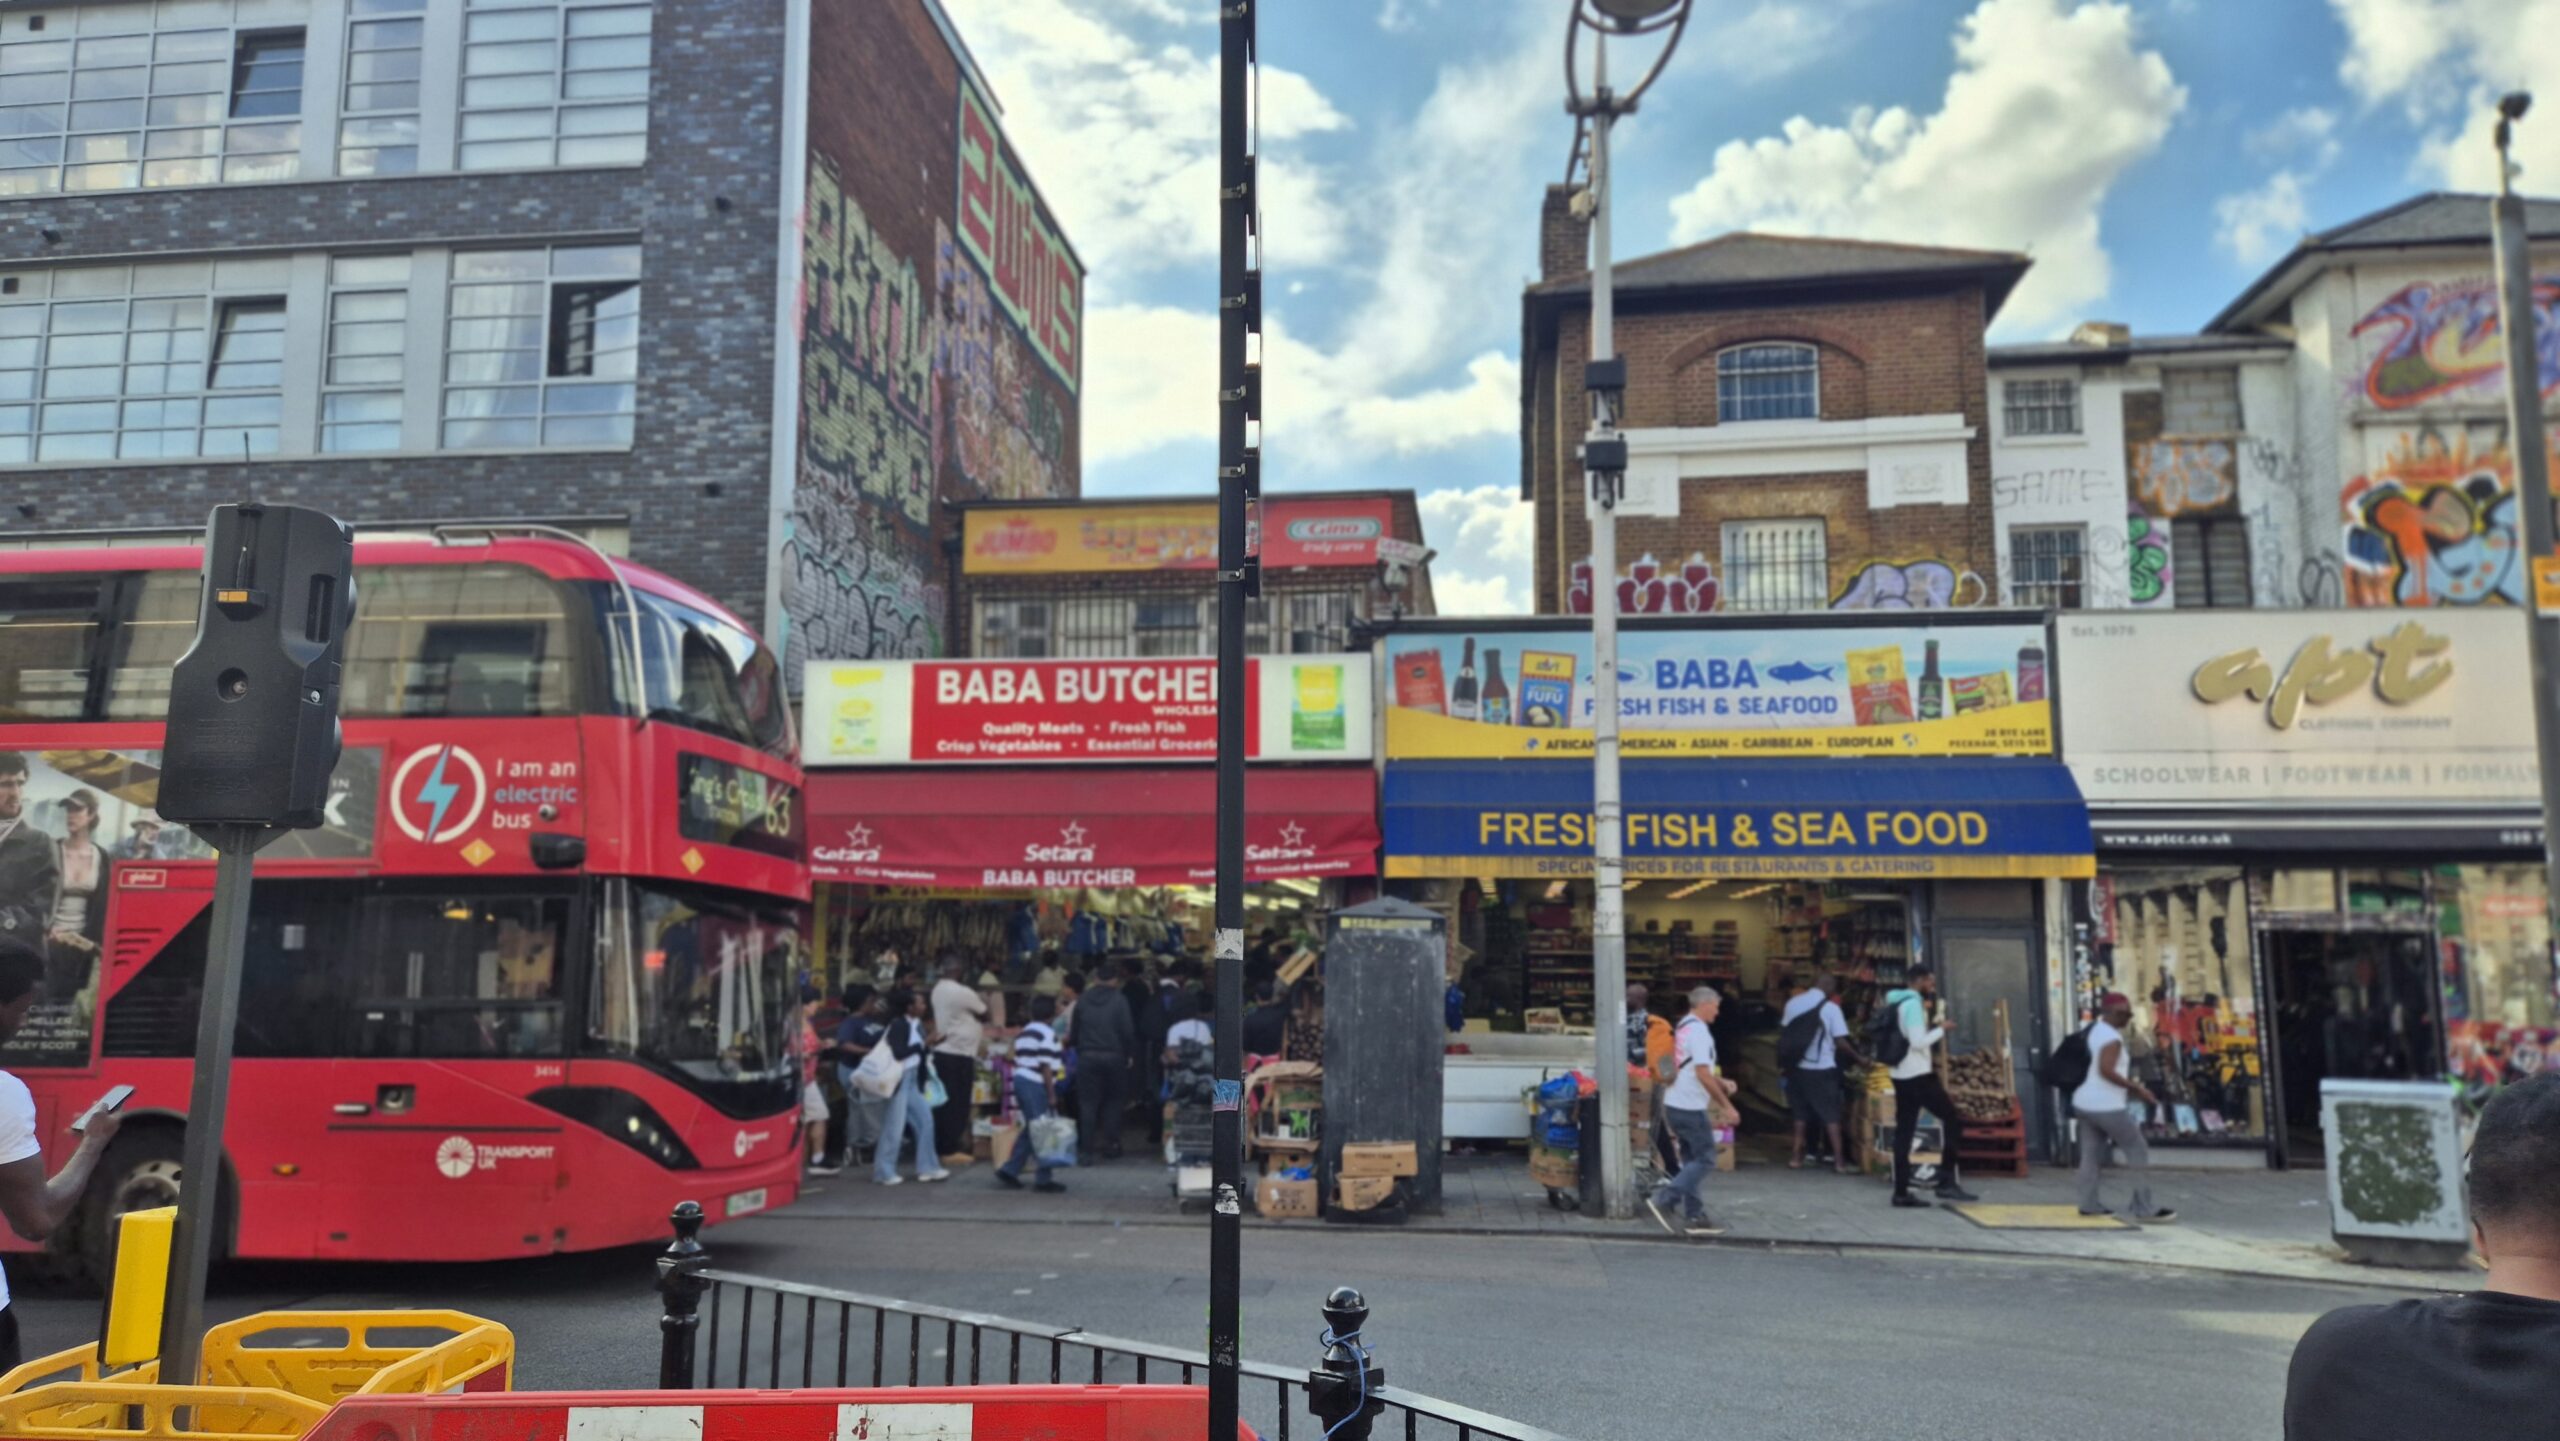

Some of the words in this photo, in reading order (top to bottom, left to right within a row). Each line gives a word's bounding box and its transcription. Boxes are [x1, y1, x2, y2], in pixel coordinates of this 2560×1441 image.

[1994, 468, 2115, 509] SAME
[1656, 659, 1759, 690] BABA
[2190, 619, 2455, 730] apt
[937, 668, 1044, 704] BABA
[1151, 706, 1218, 716] WHOLESA
[1656, 696, 1705, 716] FISH
[1712, 697, 1731, 716] &
[1737, 695, 1838, 716] SEAFOOD
[983, 722, 1034, 737] Quality
[1039, 722, 1084, 736] Meats
[1110, 721, 1151, 734] Fresh
[1155, 721, 1187, 734] Fish
[937, 740, 974, 754] Crisp
[979, 739, 1062, 753] Vegetables
[1088, 738, 1156, 752] Essential
[1690, 737, 1728, 750] ASIAN
[1741, 737, 1814, 750] CARIBBEAN
[1827, 736, 1894, 749] EUROPEAN
[496, 758, 503, 778] I
[509, 761, 543, 777] am
[549, 761, 576, 777] an
[2093, 767, 2252, 785] SCHOOLWEAR
[2281, 766, 2413, 784] FOOTWEAR
[495, 783, 577, 804] electric
[492, 809, 532, 830] bus
[765, 786, 791, 838] 63
[1626, 812, 1718, 848] FISH
[1730, 813, 1760, 847] &
[1771, 811, 1855, 847] SEA
[1867, 810, 1989, 846] FOOD
[812, 845, 880, 863] Setara
[1024, 844, 1093, 862] Setara
[1537, 860, 1596, 874] SPECIA
[1671, 860, 1705, 873] FOR
[1710, 859, 1829, 873] RESTAURANTS
[1834, 859, 1846, 872] &
[1851, 859, 1935, 873] CATERING
[982, 869, 1038, 887] BABA
[1045, 868, 1136, 887] BUTCHER
[39, 1041, 79, 1050] SCOTT
[477, 1145, 555, 1159] TRANSPORT
[477, 1157, 497, 1169] UK
